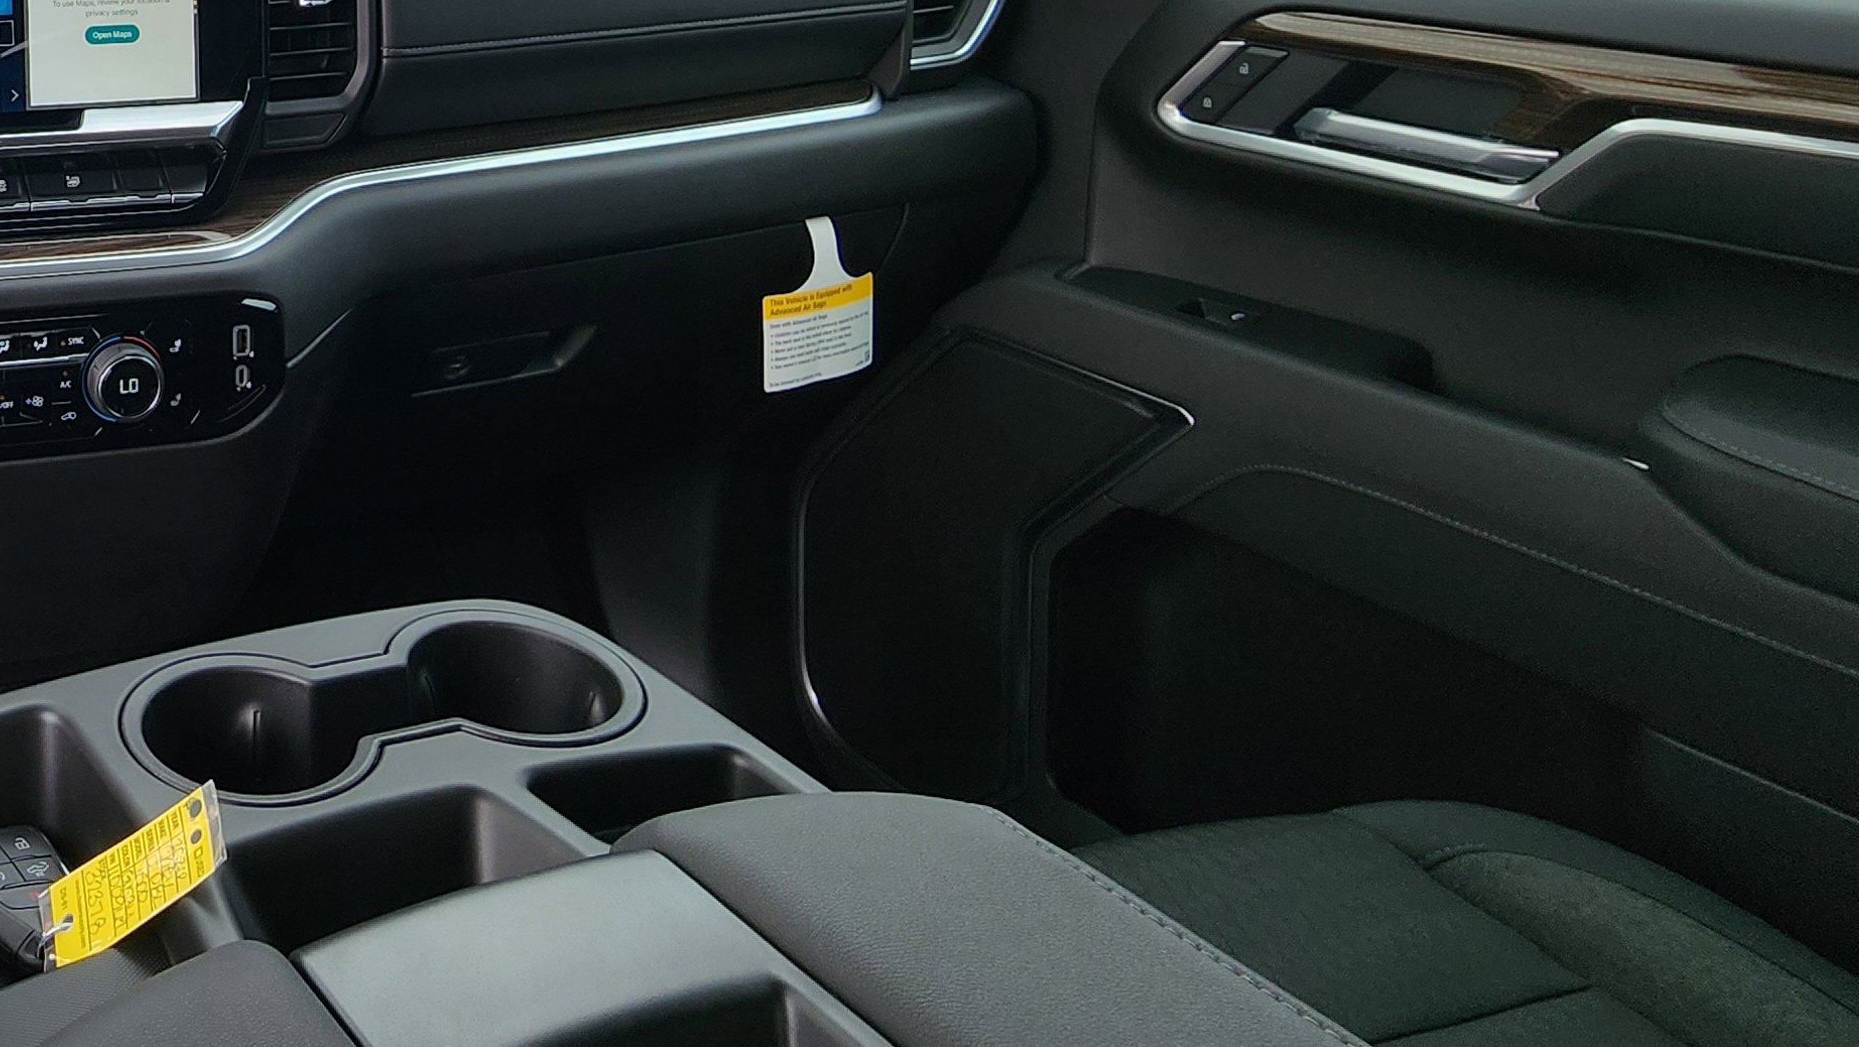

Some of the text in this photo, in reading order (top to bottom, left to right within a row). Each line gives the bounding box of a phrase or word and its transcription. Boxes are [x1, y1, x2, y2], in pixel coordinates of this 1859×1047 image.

[53, 0, 61, 8] To
[120, 0, 136, 7] your
[85, 8, 138, 18] privacy settings
[92, 30, 132, 40] Open Maps
[68, 337, 84, 346] SYNC
[60, 380, 72, 389] A/C
[119, 378, 139, 394] LO
